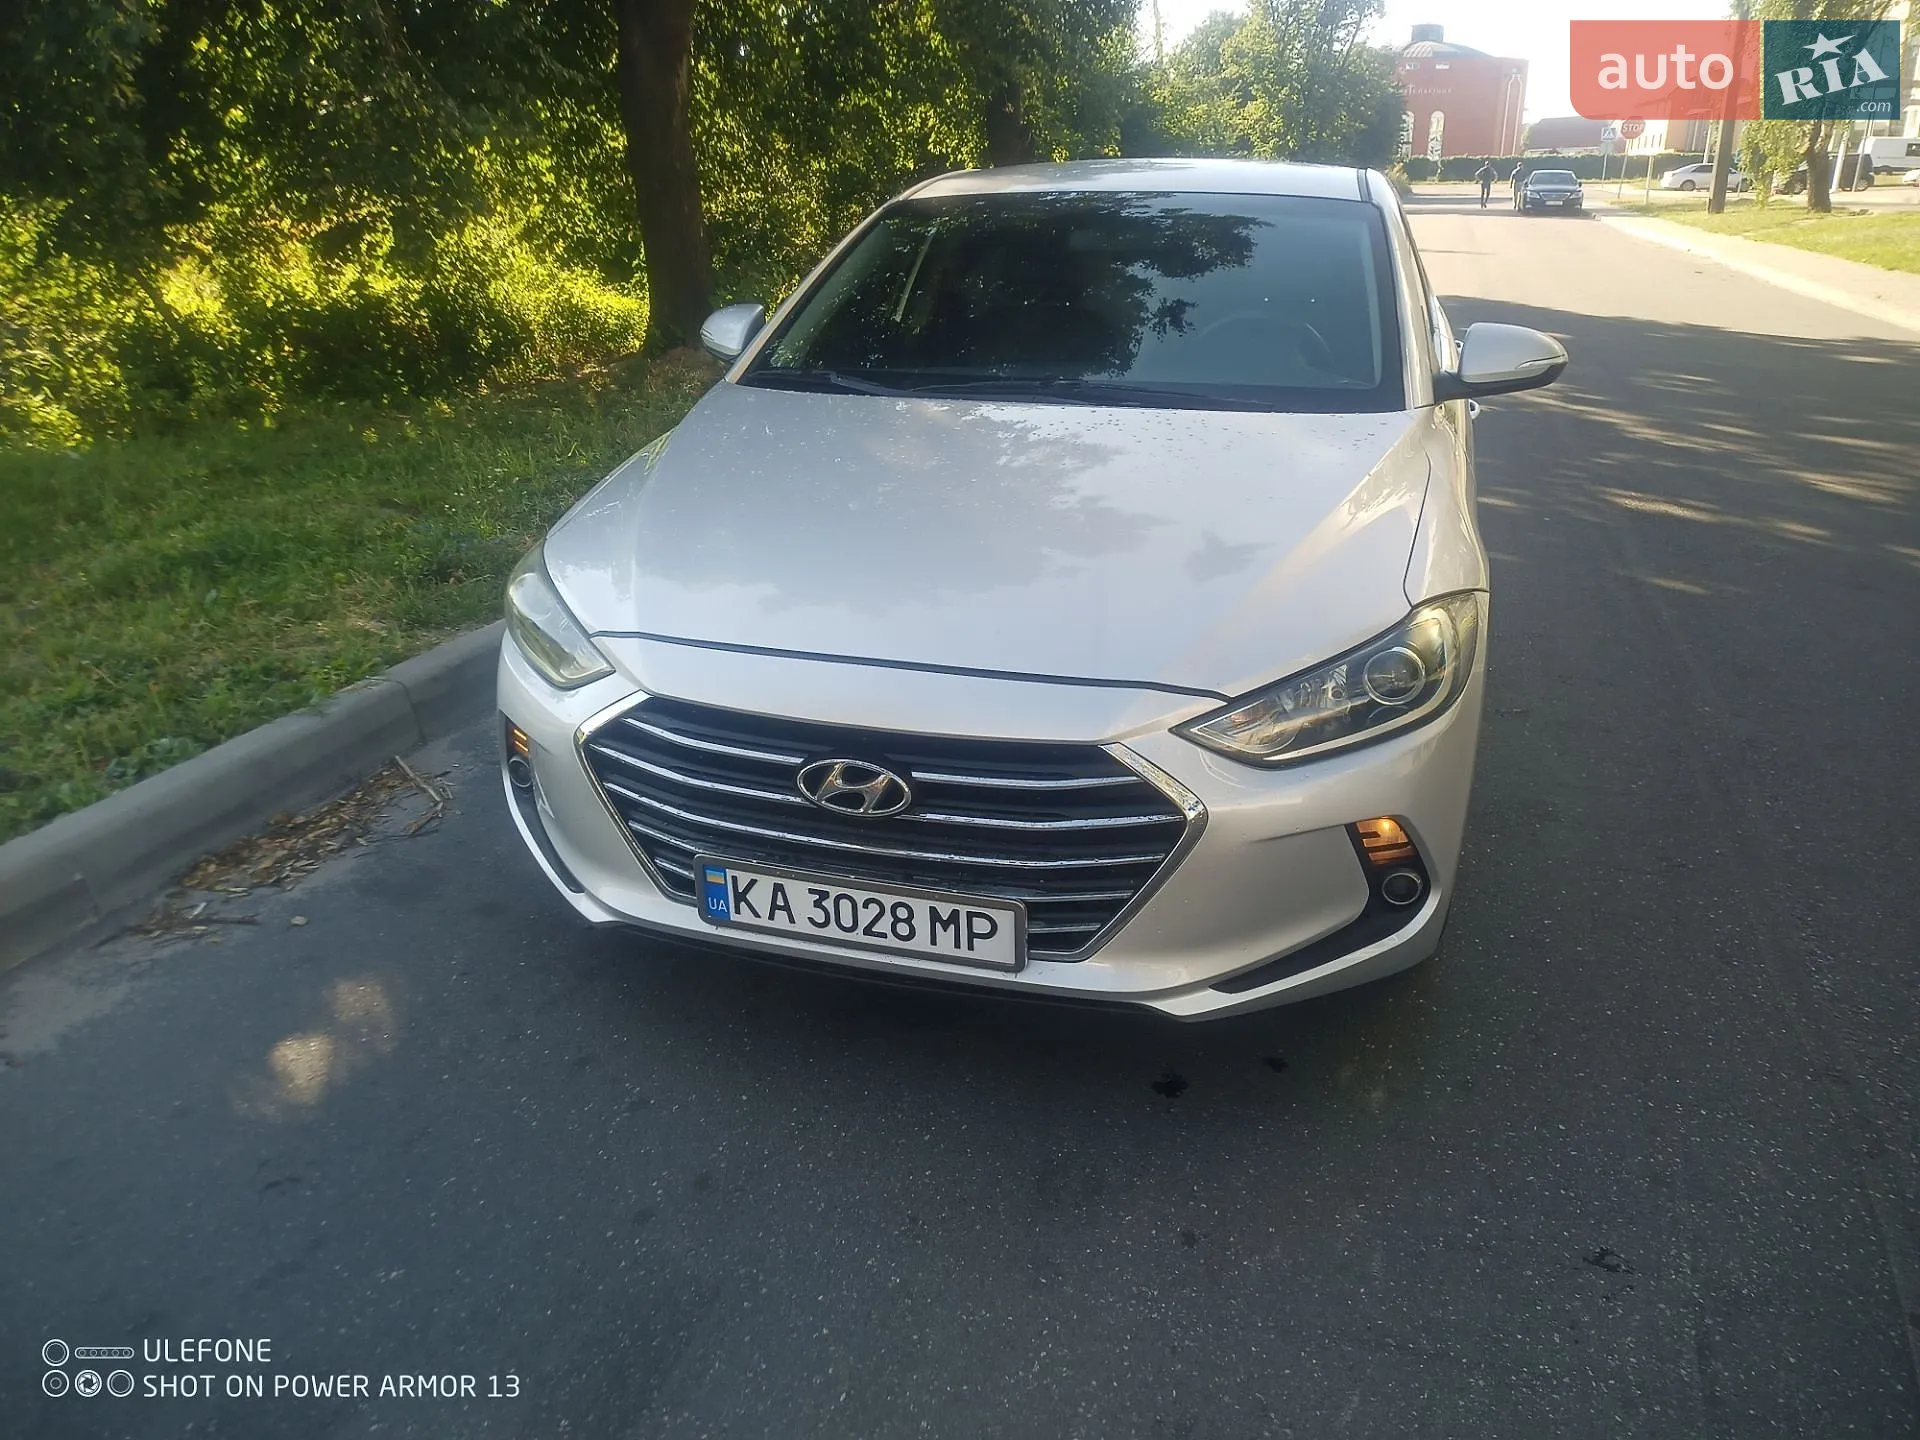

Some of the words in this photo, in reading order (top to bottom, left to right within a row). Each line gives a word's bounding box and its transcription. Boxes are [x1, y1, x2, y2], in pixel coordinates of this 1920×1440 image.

[708, 896, 728, 913] UA
[731, 875, 796, 924] KA
[807, 887, 917, 942] 3028
[929, 905, 999, 951] MP
